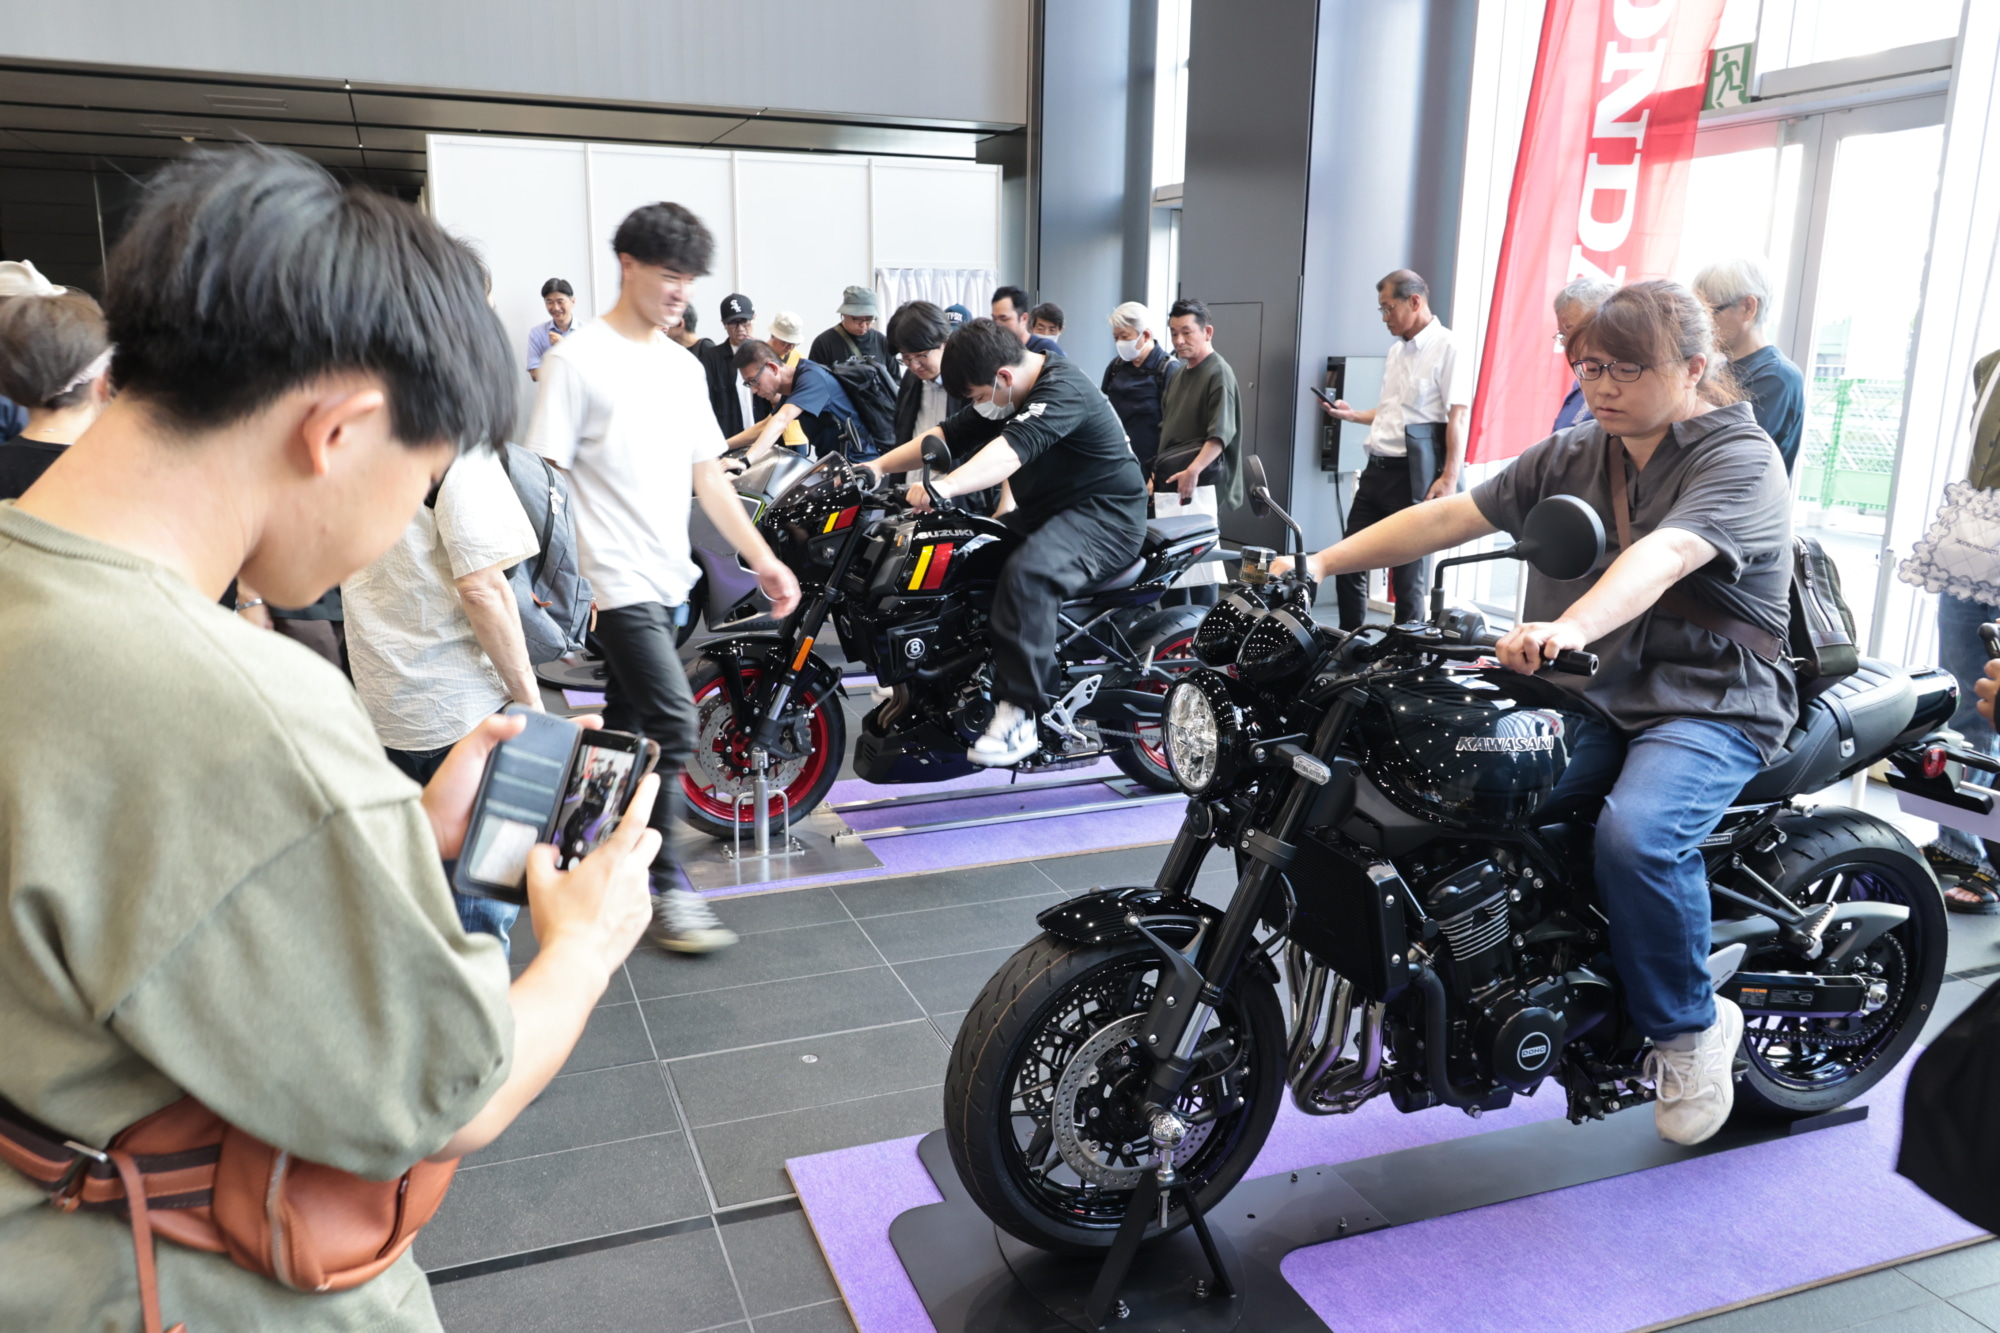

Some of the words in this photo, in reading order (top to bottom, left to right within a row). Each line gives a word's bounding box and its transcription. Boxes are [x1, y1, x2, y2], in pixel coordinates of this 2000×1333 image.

[915, 528, 975, 540] SUZUKI
[910, 641, 921, 654] 8
[1455, 735, 1555, 752] KAWASAKI
[1522, 1046, 1546, 1056] DOHC
